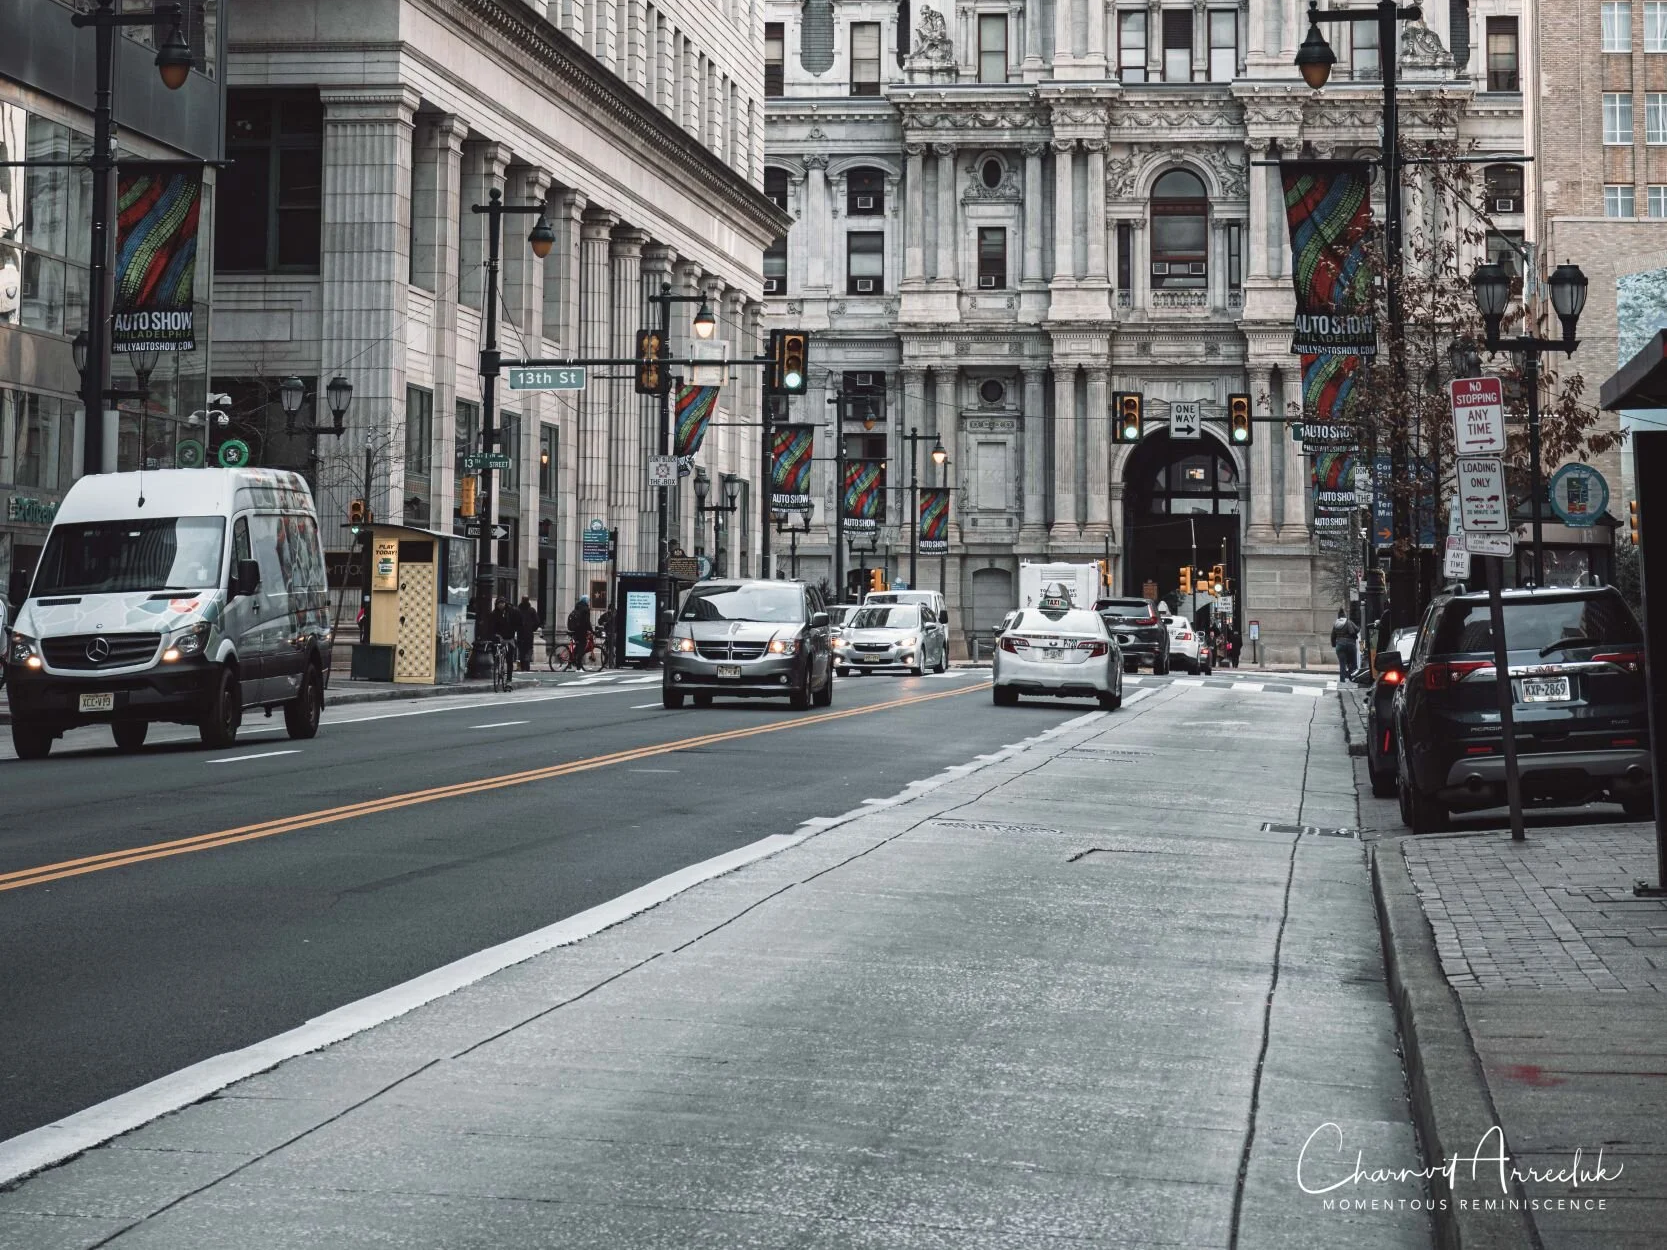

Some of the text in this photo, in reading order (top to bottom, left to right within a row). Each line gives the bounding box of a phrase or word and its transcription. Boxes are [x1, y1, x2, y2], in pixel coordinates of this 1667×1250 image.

[114, 311, 193, 331] AUTO SHOW
[1295, 313, 1373, 335] AUTO SHOW
[113, 330, 193, 339] PHILADELPHIA
[113, 341, 194, 352] PHILLYAUTOSHOW.COM
[518, 371, 577, 384] 13th St
[1469, 381, 1482, 392] NO
[1456, 392, 1498, 405] STOPPING
[1175, 404, 1196, 414] ONE
[1175, 414, 1196, 423] WAY
[1467, 408, 1489, 422] ANY
[1304, 424, 1329, 438] AUTO
[1466, 422, 1493, 436] TIME
[1462, 462, 1497, 473] LOADING
[663, 478, 676, 486] BOX
[1470, 477, 1491, 488] ONLY
[772, 493, 809, 504] AUTO SHOW
[1319, 491, 1337, 502] AUTO
[1357, 494, 1371, 503] THE
[843, 518, 876, 527] AUTO SHOW
[1314, 517, 1331, 526] AUTO
[920, 540, 933, 548] AUTO
[1451, 552, 1464, 560] ANY
[1450, 560, 1465, 569] TIME
